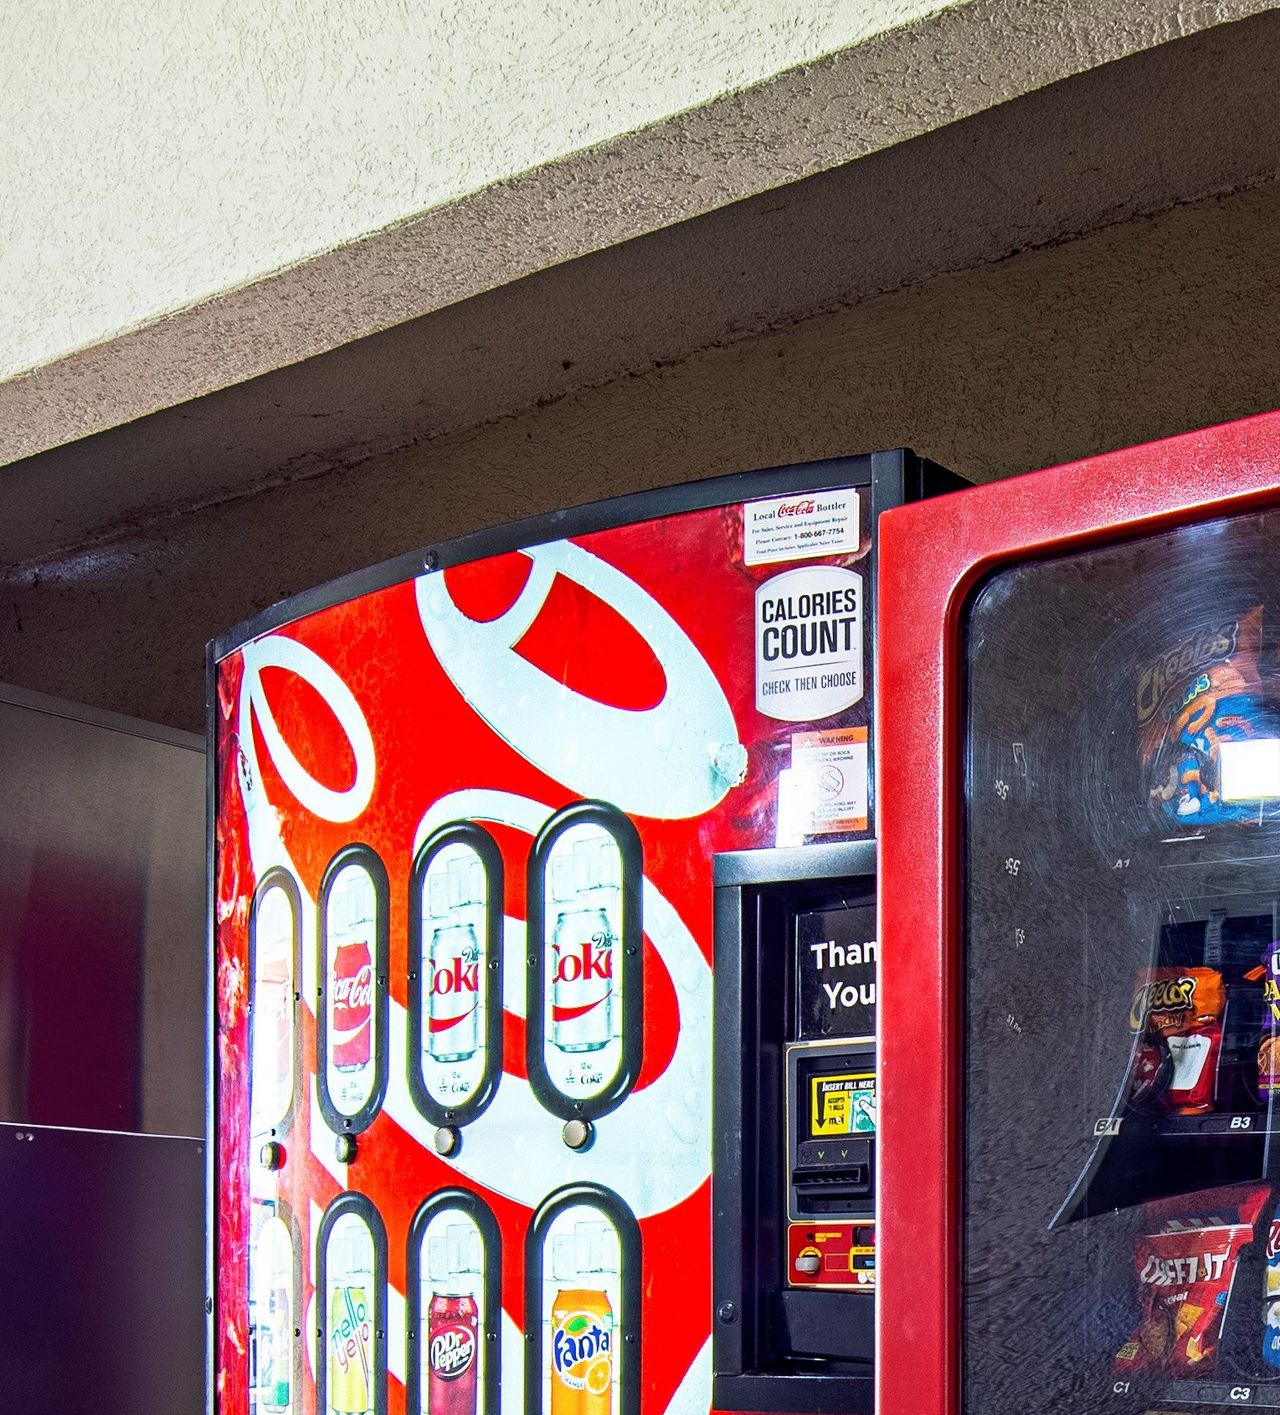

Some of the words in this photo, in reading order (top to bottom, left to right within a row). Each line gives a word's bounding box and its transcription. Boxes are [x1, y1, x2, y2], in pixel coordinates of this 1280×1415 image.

[753, 511, 776, 522] Local
[816, 502, 847, 512] Bottler
[762, 588, 856, 623] CALORIES
[762, 617, 857, 662] COUNT
[762, 678, 792, 696] CHECK
[794, 675, 818, 692] THEN
[821, 671, 857, 689] CHOOSE
[811, 940, 876, 970] Than
[823, 981, 876, 1009] You
[822, 1081, 843, 1092] INSERT
[844, 1080, 857, 1090] BILL
[1230, 1117, 1251, 1129] B3
[433, 1335, 472, 1371] Pepper
[448, 1332, 464, 1350] Dr
[554, 1324, 610, 1373] Fanta
[1113, 1381, 1130, 1394] C1
[1230, 1387, 1251, 1400] C3
